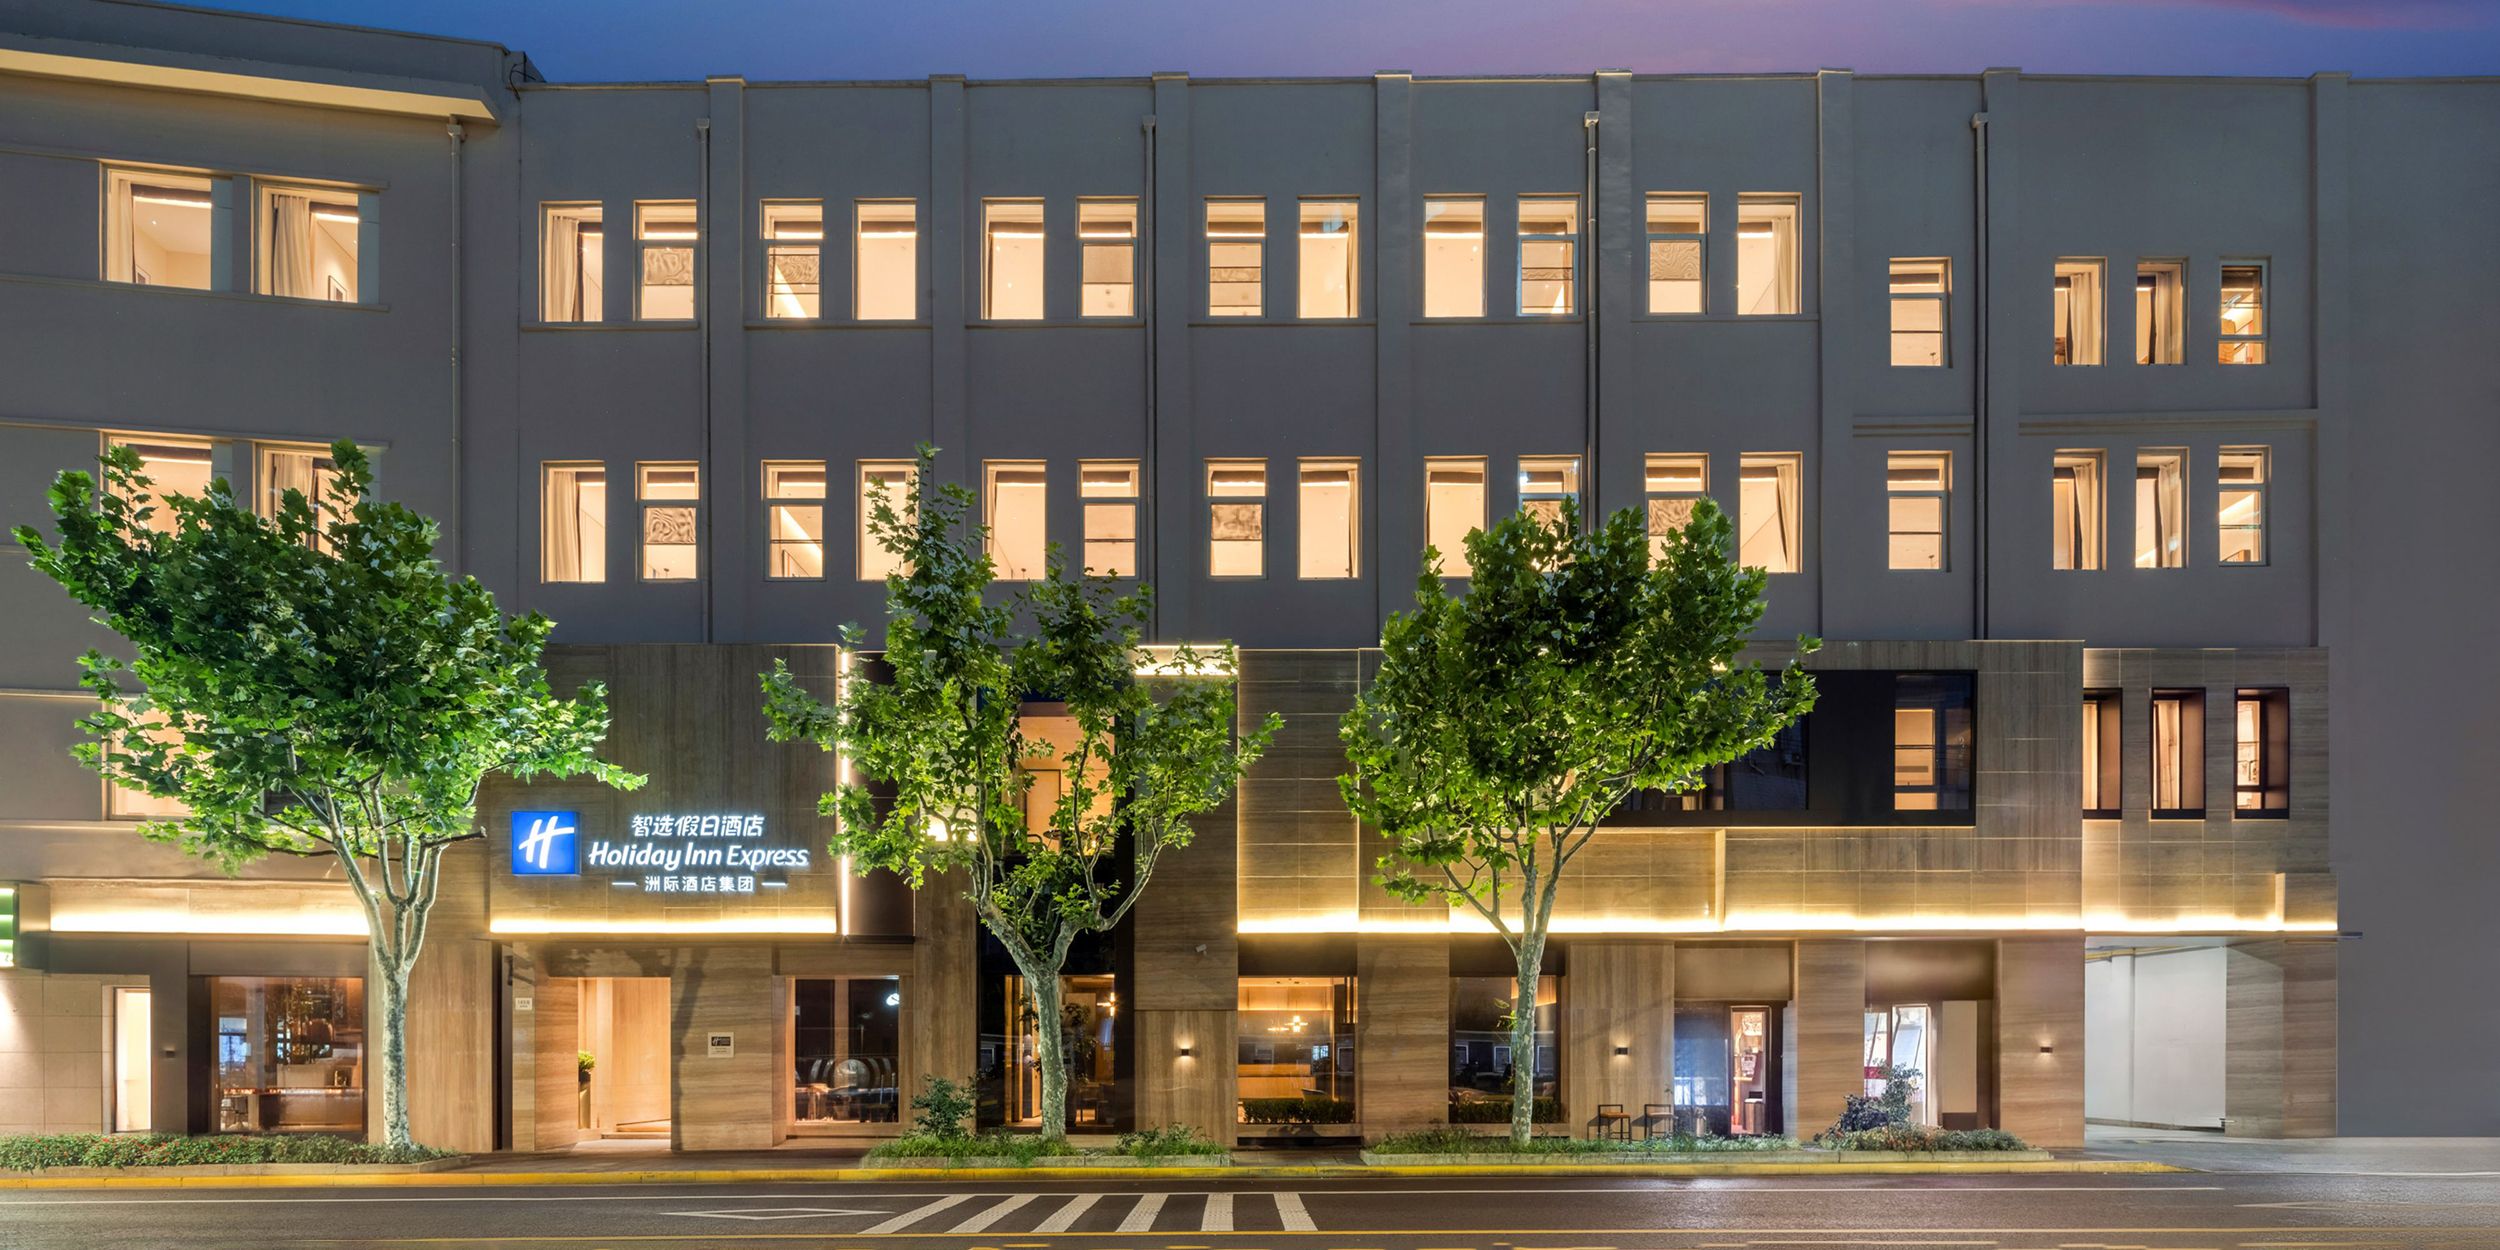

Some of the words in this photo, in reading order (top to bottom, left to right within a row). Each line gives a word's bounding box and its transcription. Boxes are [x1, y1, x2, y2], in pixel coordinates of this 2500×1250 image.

[631, 814, 764, 837] 智选假日酒店
[588, 841, 682, 871] Holiday
[684, 842, 722, 866] Inn
[726, 845, 810, 872] Express
[644, 875, 754, 892] 洲际酒店集团
